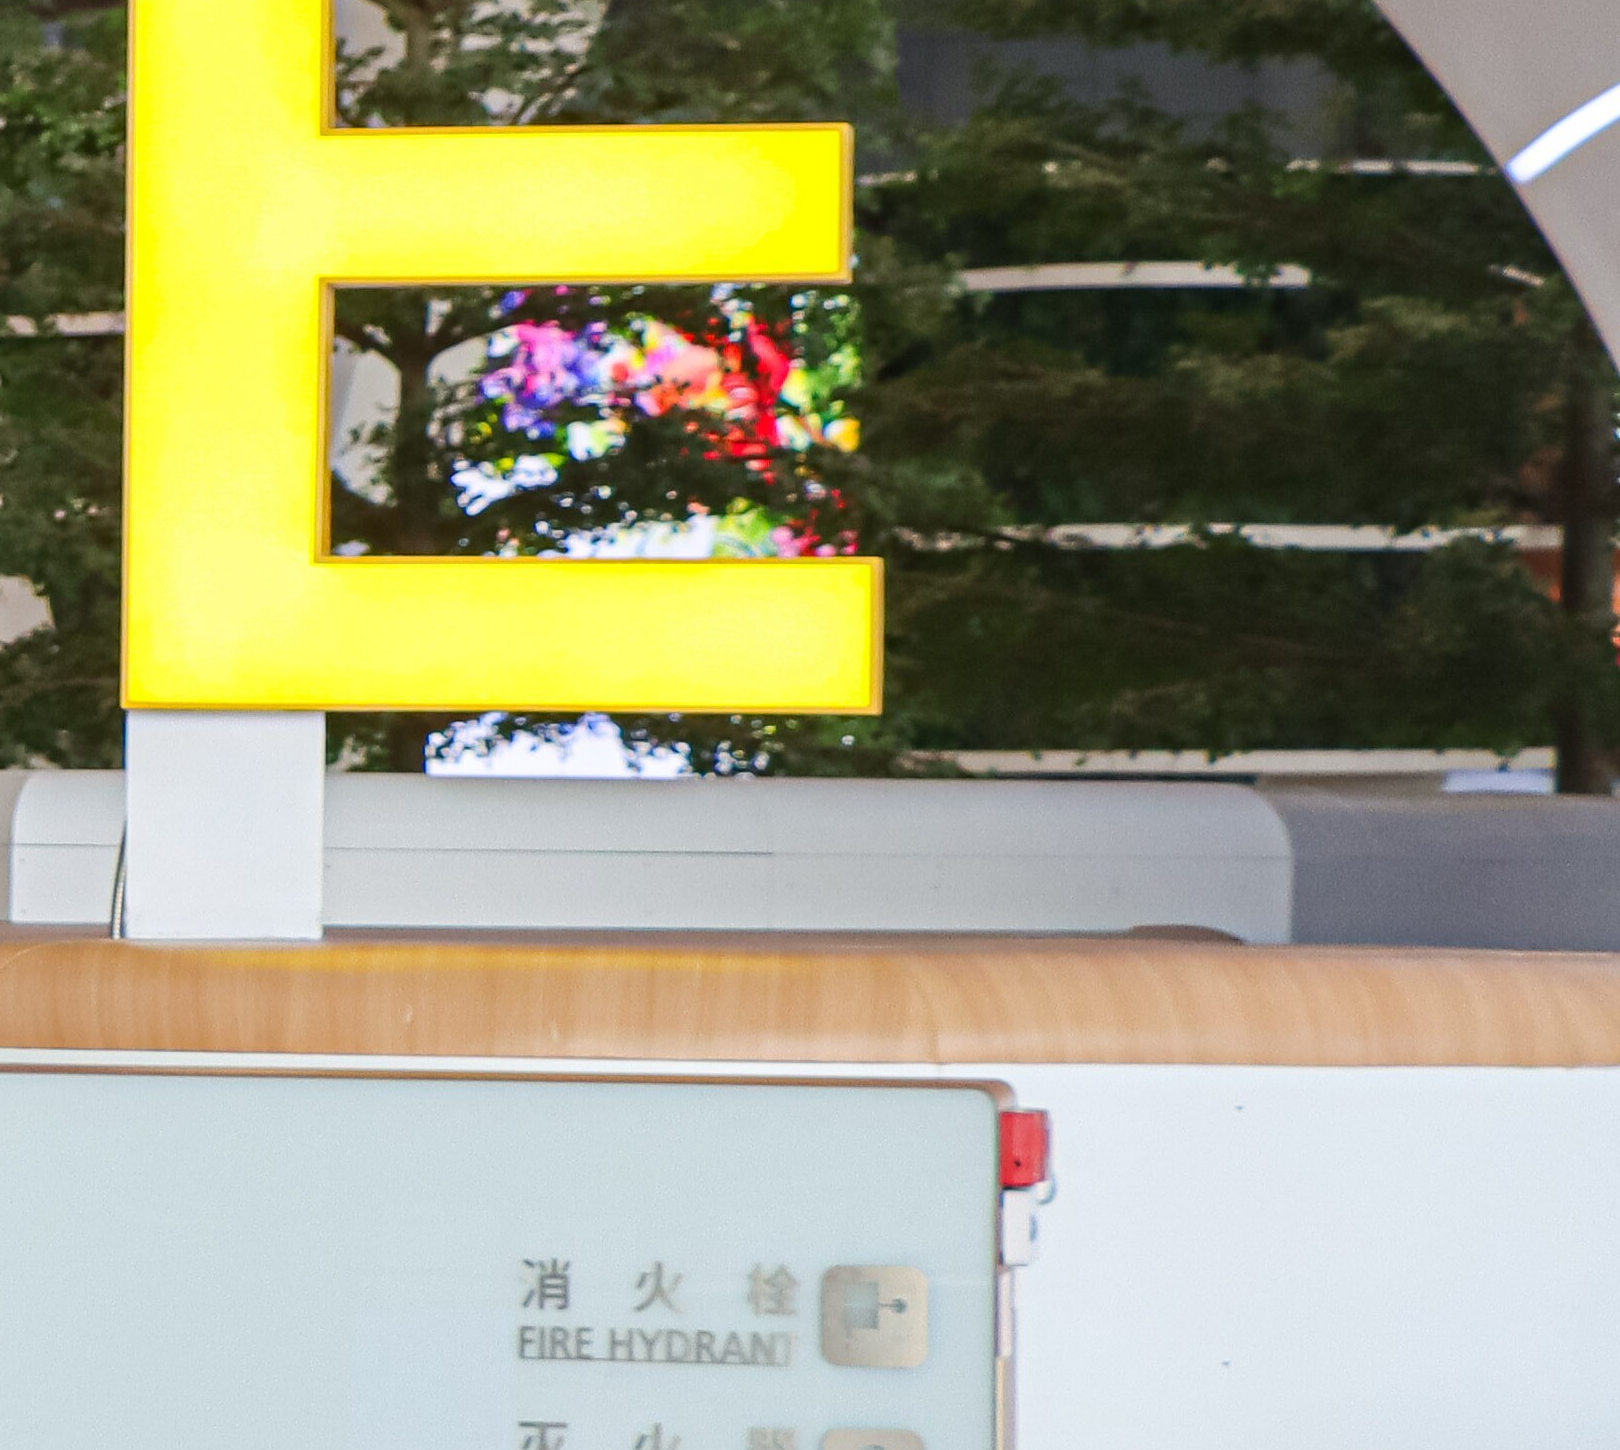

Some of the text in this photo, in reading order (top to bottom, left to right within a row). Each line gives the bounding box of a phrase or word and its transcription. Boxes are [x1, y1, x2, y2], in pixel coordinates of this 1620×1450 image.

[522, 1257, 799, 1317] 消火栓
[517, 1325, 799, 1367] FIRE HYDRANT
